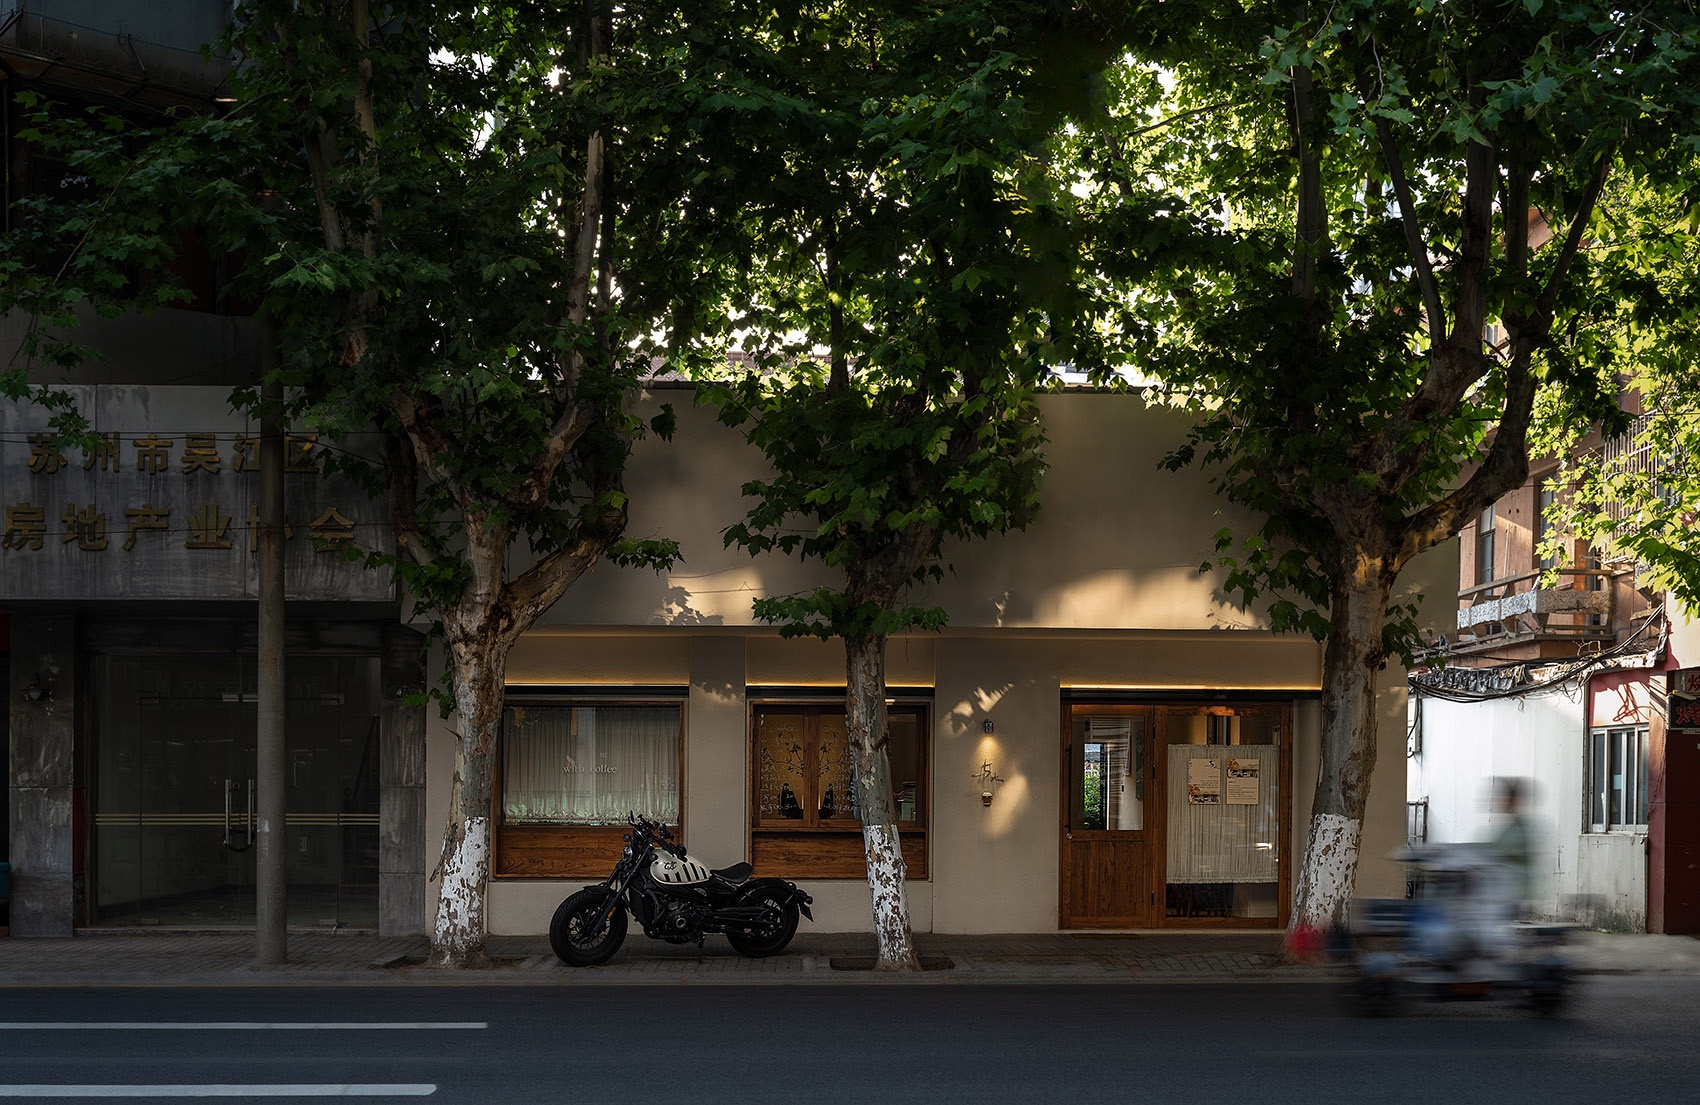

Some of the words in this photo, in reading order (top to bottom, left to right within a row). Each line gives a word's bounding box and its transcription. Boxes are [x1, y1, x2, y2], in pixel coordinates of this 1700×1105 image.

[27, 432, 319, 474] 苏州市吴江区
[562, 764, 585, 774] with
[590, 764, 617, 774] coffee
